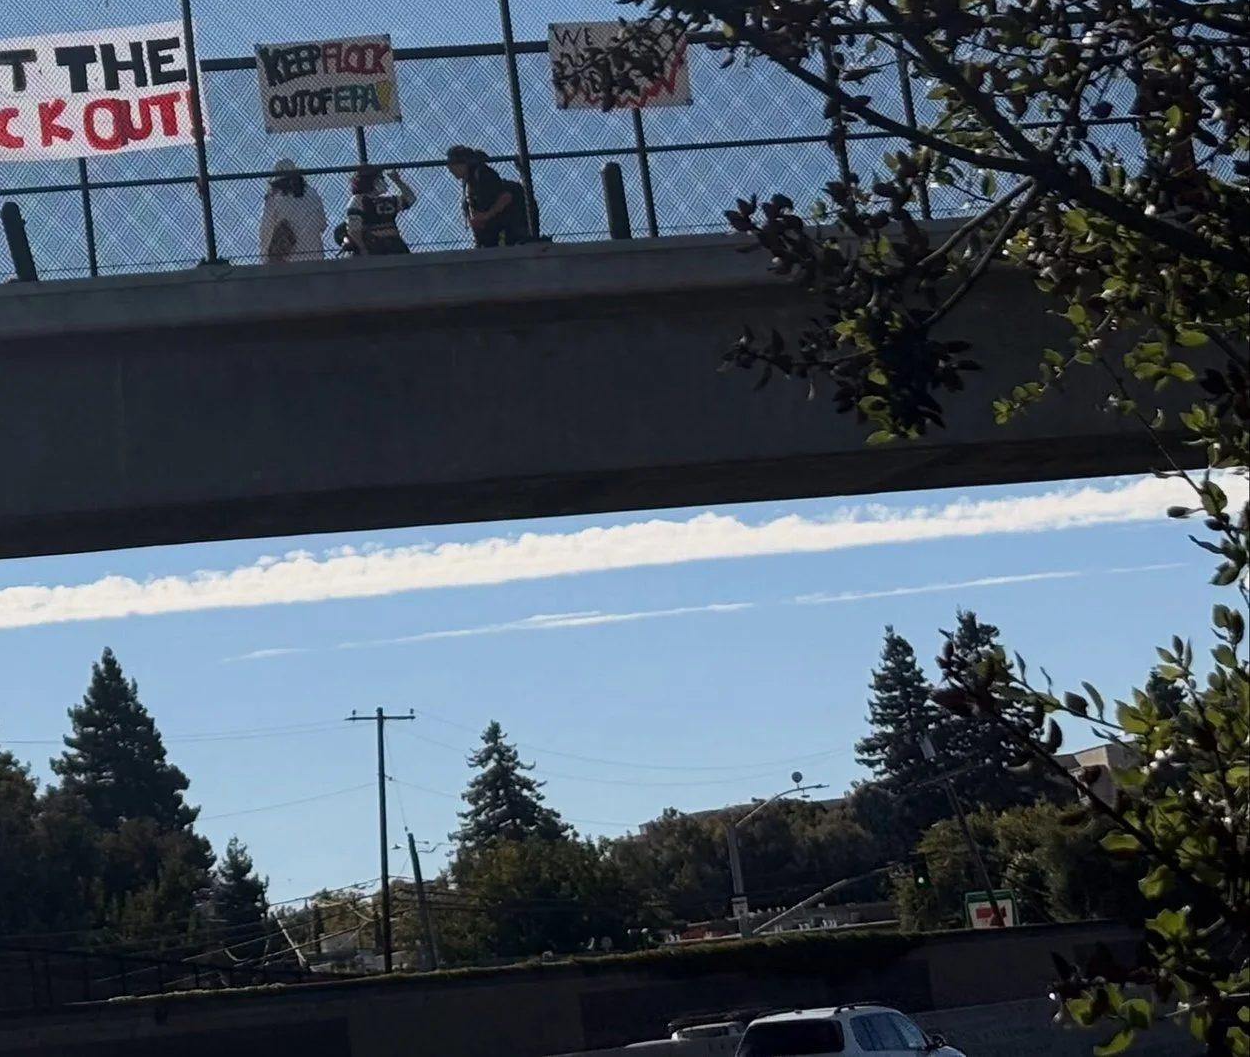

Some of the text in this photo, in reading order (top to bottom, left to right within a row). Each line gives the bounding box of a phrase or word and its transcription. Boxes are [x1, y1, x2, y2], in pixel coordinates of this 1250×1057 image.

[55, 37, 188, 93] THE
[258, 42, 391, 87] KEEP FLOCK
